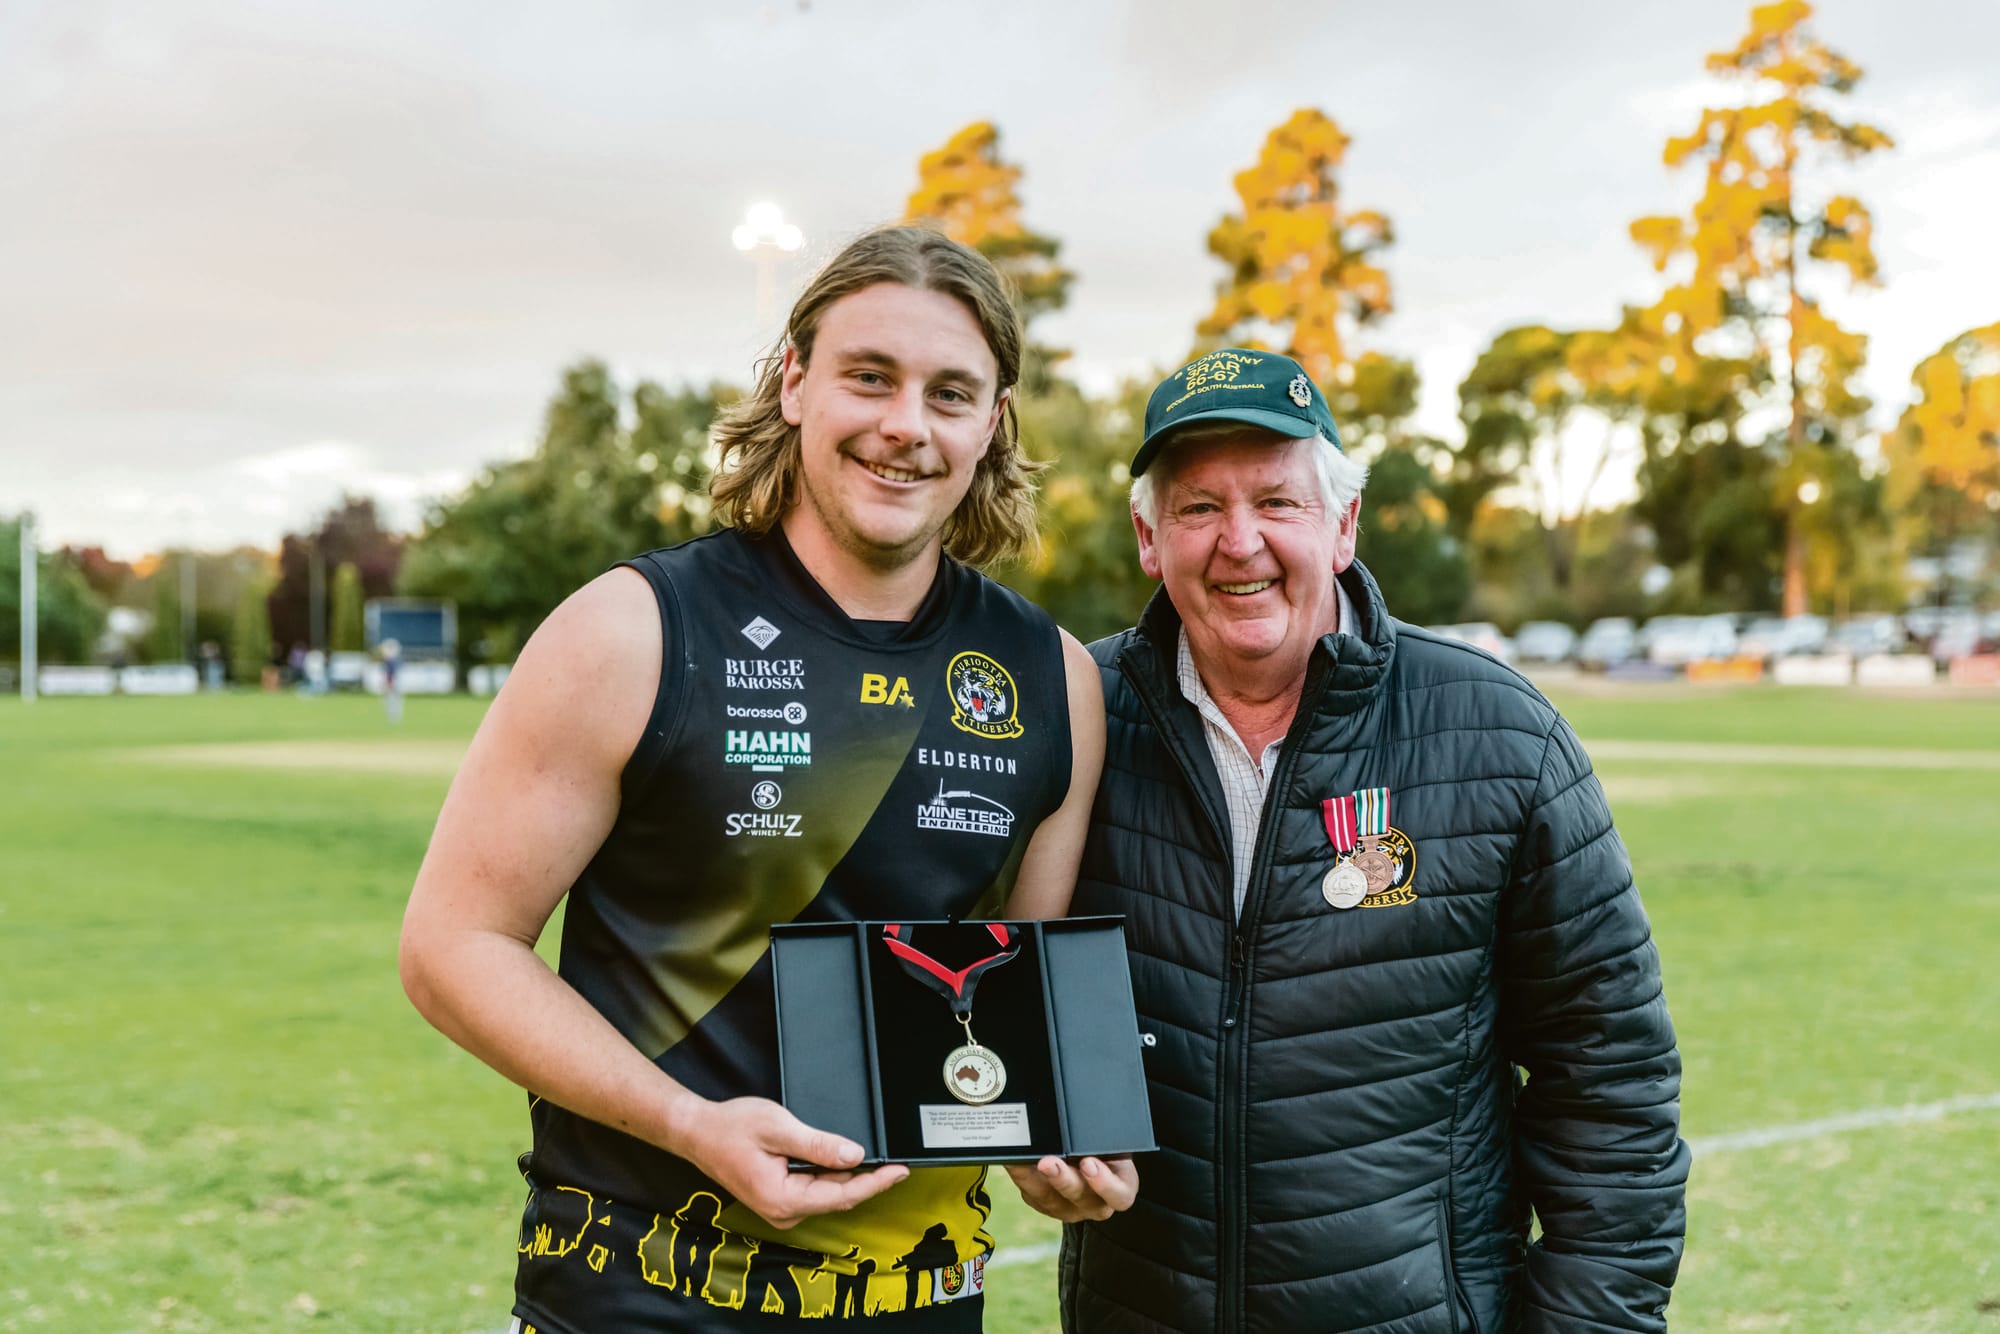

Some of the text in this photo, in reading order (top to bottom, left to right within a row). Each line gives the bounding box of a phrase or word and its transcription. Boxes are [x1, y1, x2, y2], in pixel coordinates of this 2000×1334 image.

[1185, 360, 1241, 381] 3RAR
[1187, 352, 1263, 371] COMPANY
[1186, 370, 1238, 391] 66-67
[1197, 383, 1222, 394] SOUTH
[725, 658, 805, 676] BURGE
[953, 656, 1008, 688] NURIOOTPA
[726, 676, 805, 690] BAROSSA
[727, 704, 783, 719] barossa
[968, 718, 1010, 734] TIGERS
[725, 730, 811, 753] HAHN
[725, 753, 811, 765] CORPORATION
[918, 748, 1017, 775] ELDERTON
[725, 813, 803, 838] SCHULZ
[919, 818, 1009, 835] ENGINEERING
[1363, 893, 1400, 905] GERS
